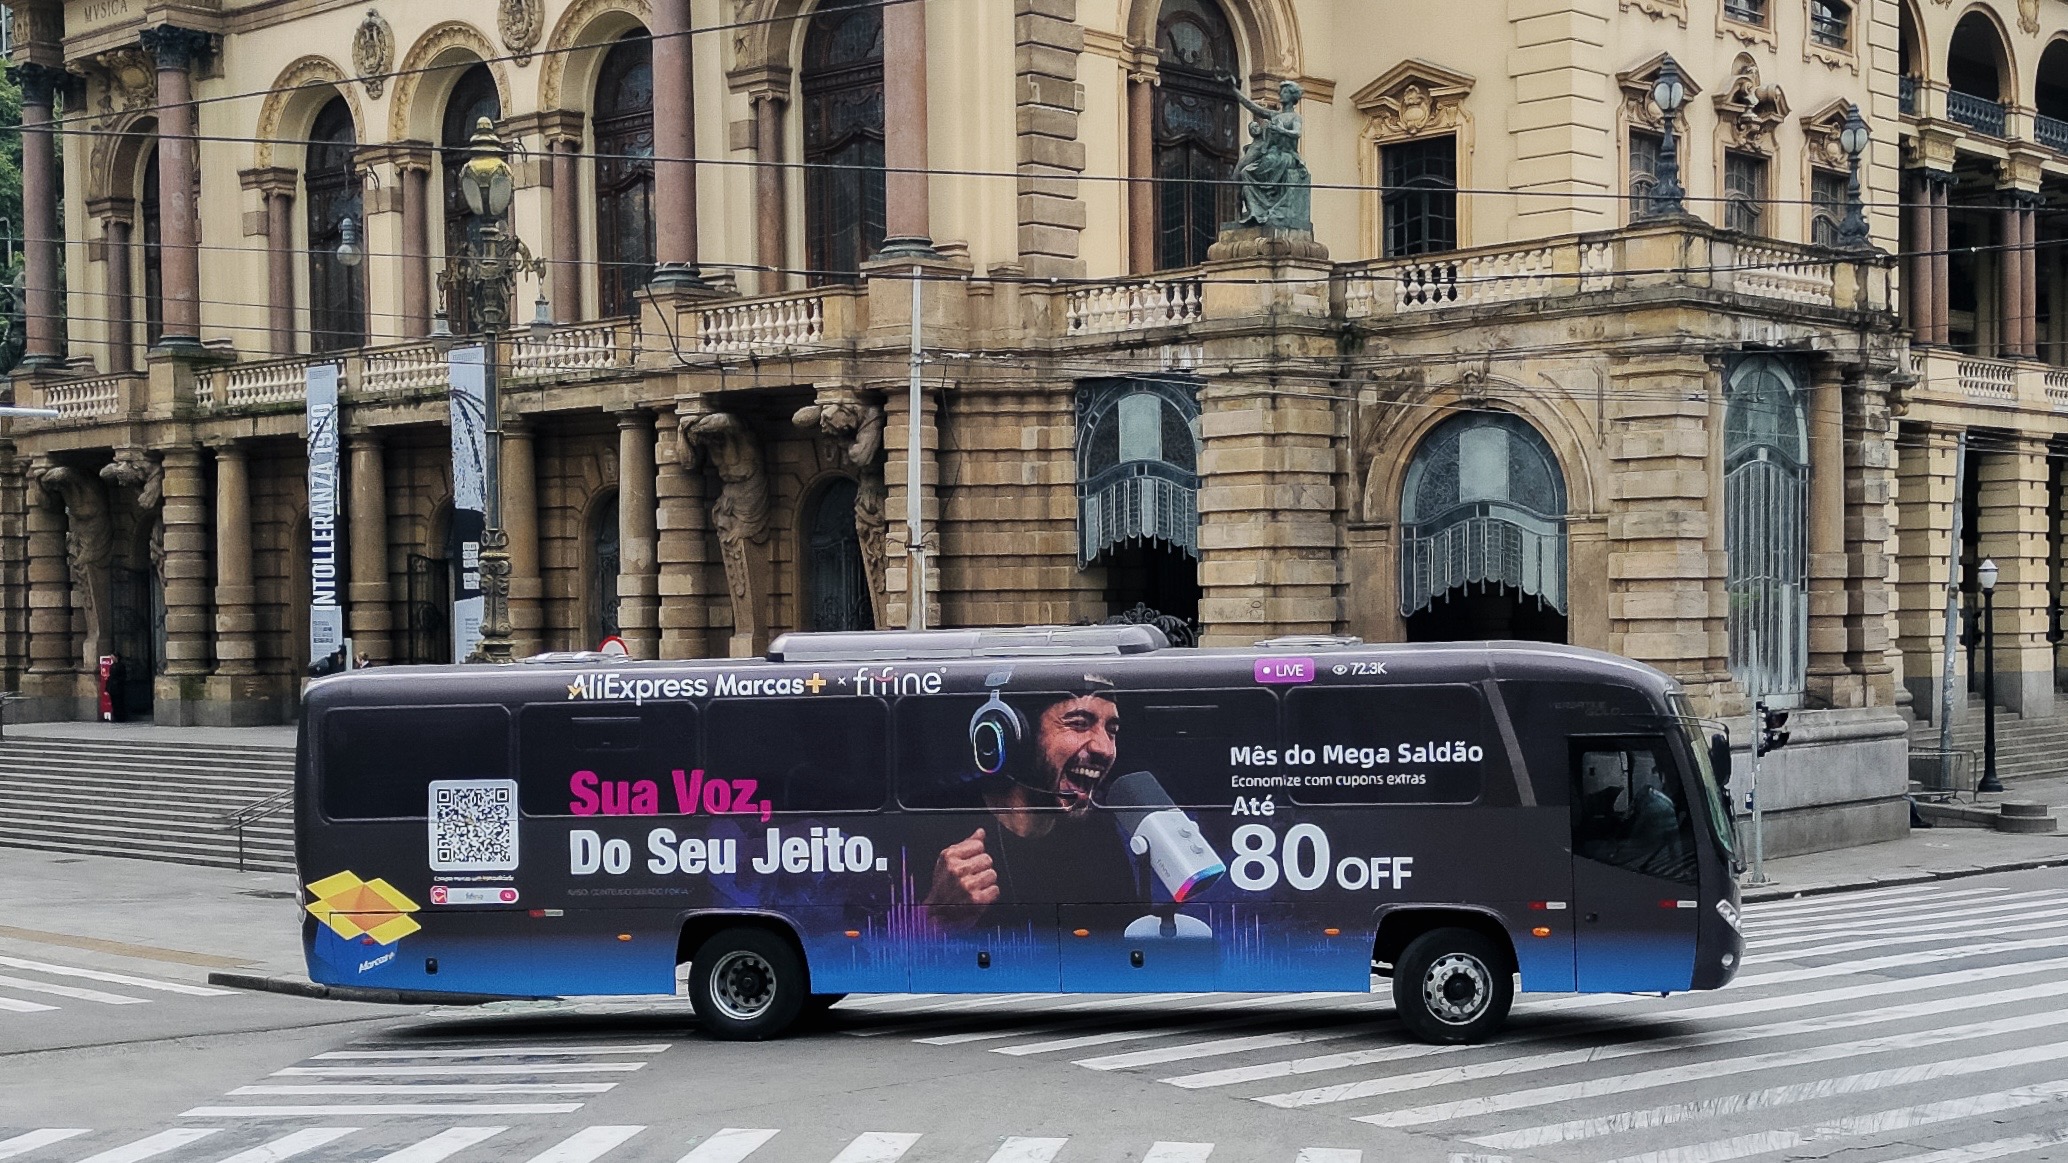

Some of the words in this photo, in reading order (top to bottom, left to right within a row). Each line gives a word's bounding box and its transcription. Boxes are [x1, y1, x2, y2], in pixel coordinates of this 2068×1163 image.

[84, 0, 128, 22] MVSICA
[311, 461, 336, 611] INTOLLERANZA
[1275, 664, 1304, 677] LIVE
[1350, 661, 1388, 676] 72.3K
[567, 673, 708, 706] AliExpress
[1230, 745, 1278, 766] Mês
[1284, 744, 1316, 765] do
[1322, 744, 1390, 769] Mega
[1397, 740, 1484, 764] Saldão
[1231, 775, 1302, 787] Economize
[1304, 776, 1333, 787] com
[1335, 775, 1384, 788] cupons
[1386, 772, 1427, 786] extras
[569, 770, 659, 817] Sua
[671, 769, 773, 823] Voz,
[1231, 794, 1276, 816] Até
[569, 829, 632, 876] Do
[647, 828, 738, 875] Seu
[751, 826, 889, 875] Jeito.
[1229, 823, 1331, 891] 80
[1336, 856, 1414, 890] OFF
